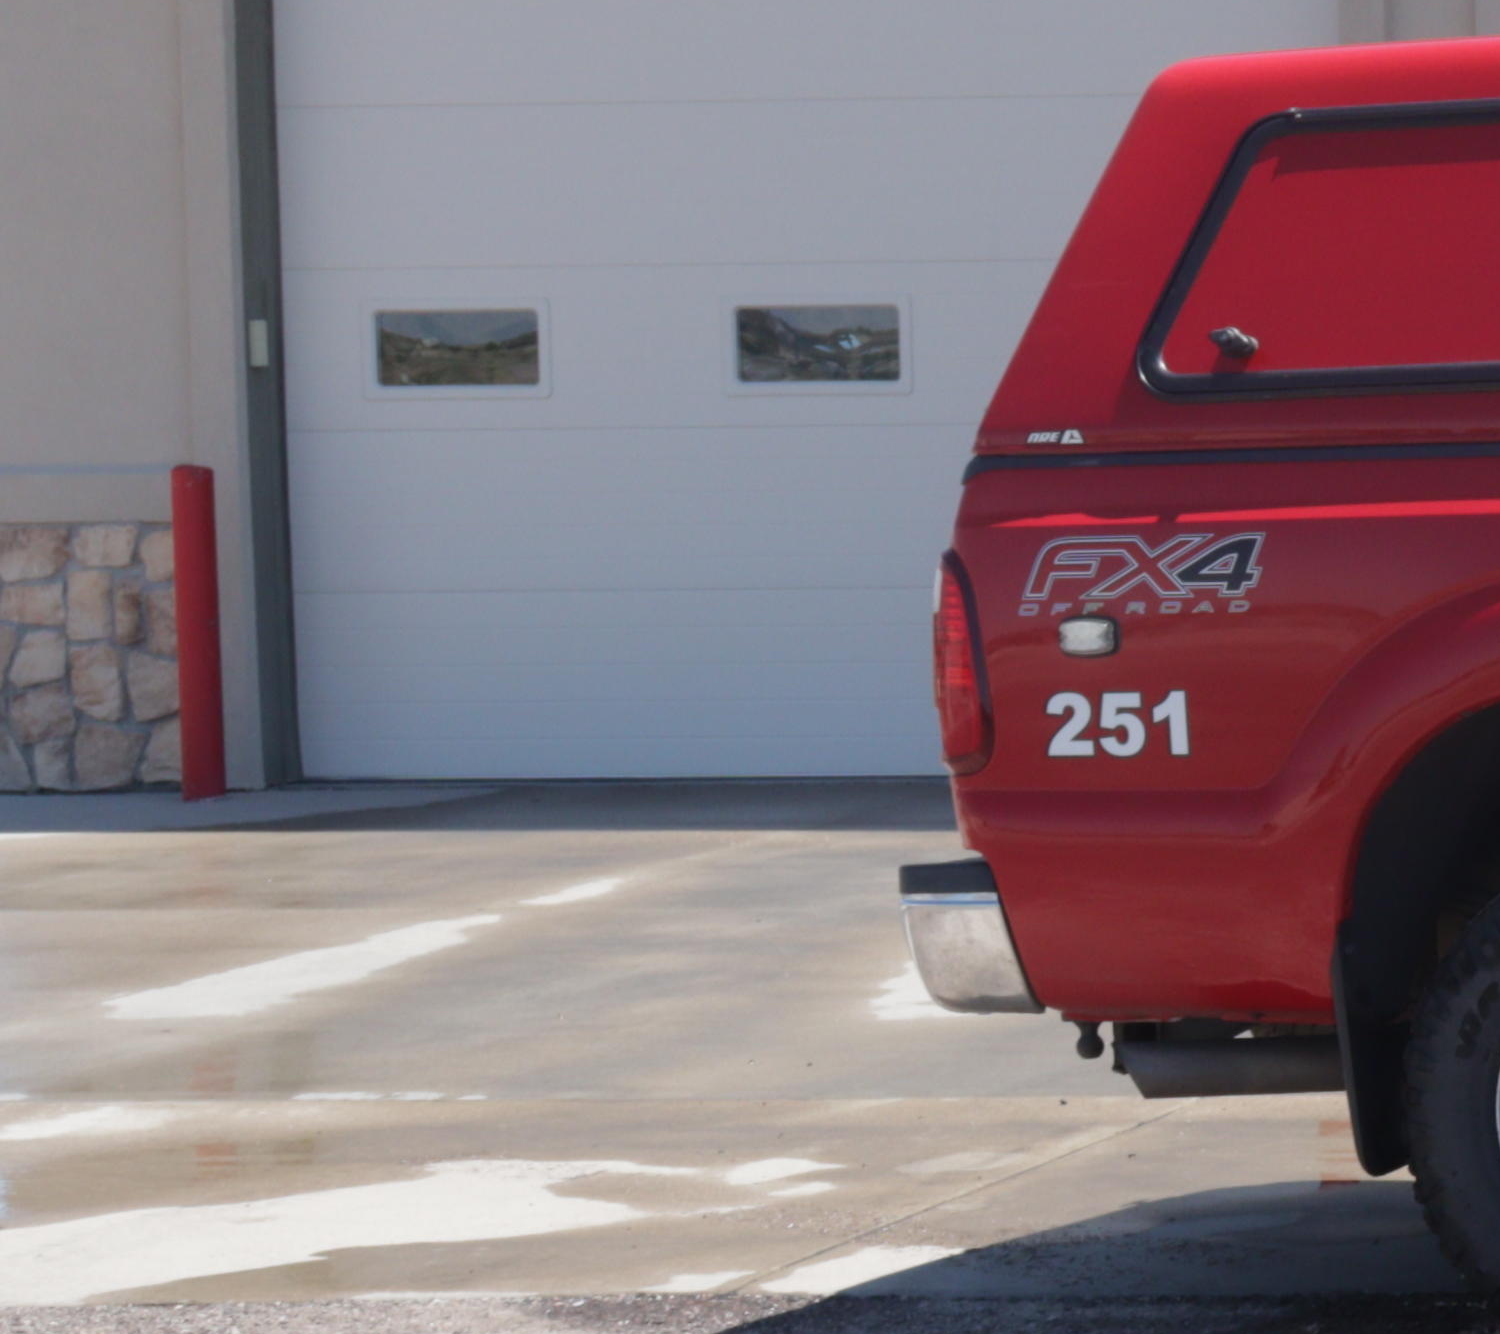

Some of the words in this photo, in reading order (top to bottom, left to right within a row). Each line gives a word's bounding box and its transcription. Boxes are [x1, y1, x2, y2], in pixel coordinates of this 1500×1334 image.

[1022, 532, 1267, 600] FX4
[1018, 602, 1104, 616] OFF
[1125, 600, 1251, 615] ROAD
[1046, 689, 1190, 758] 251
